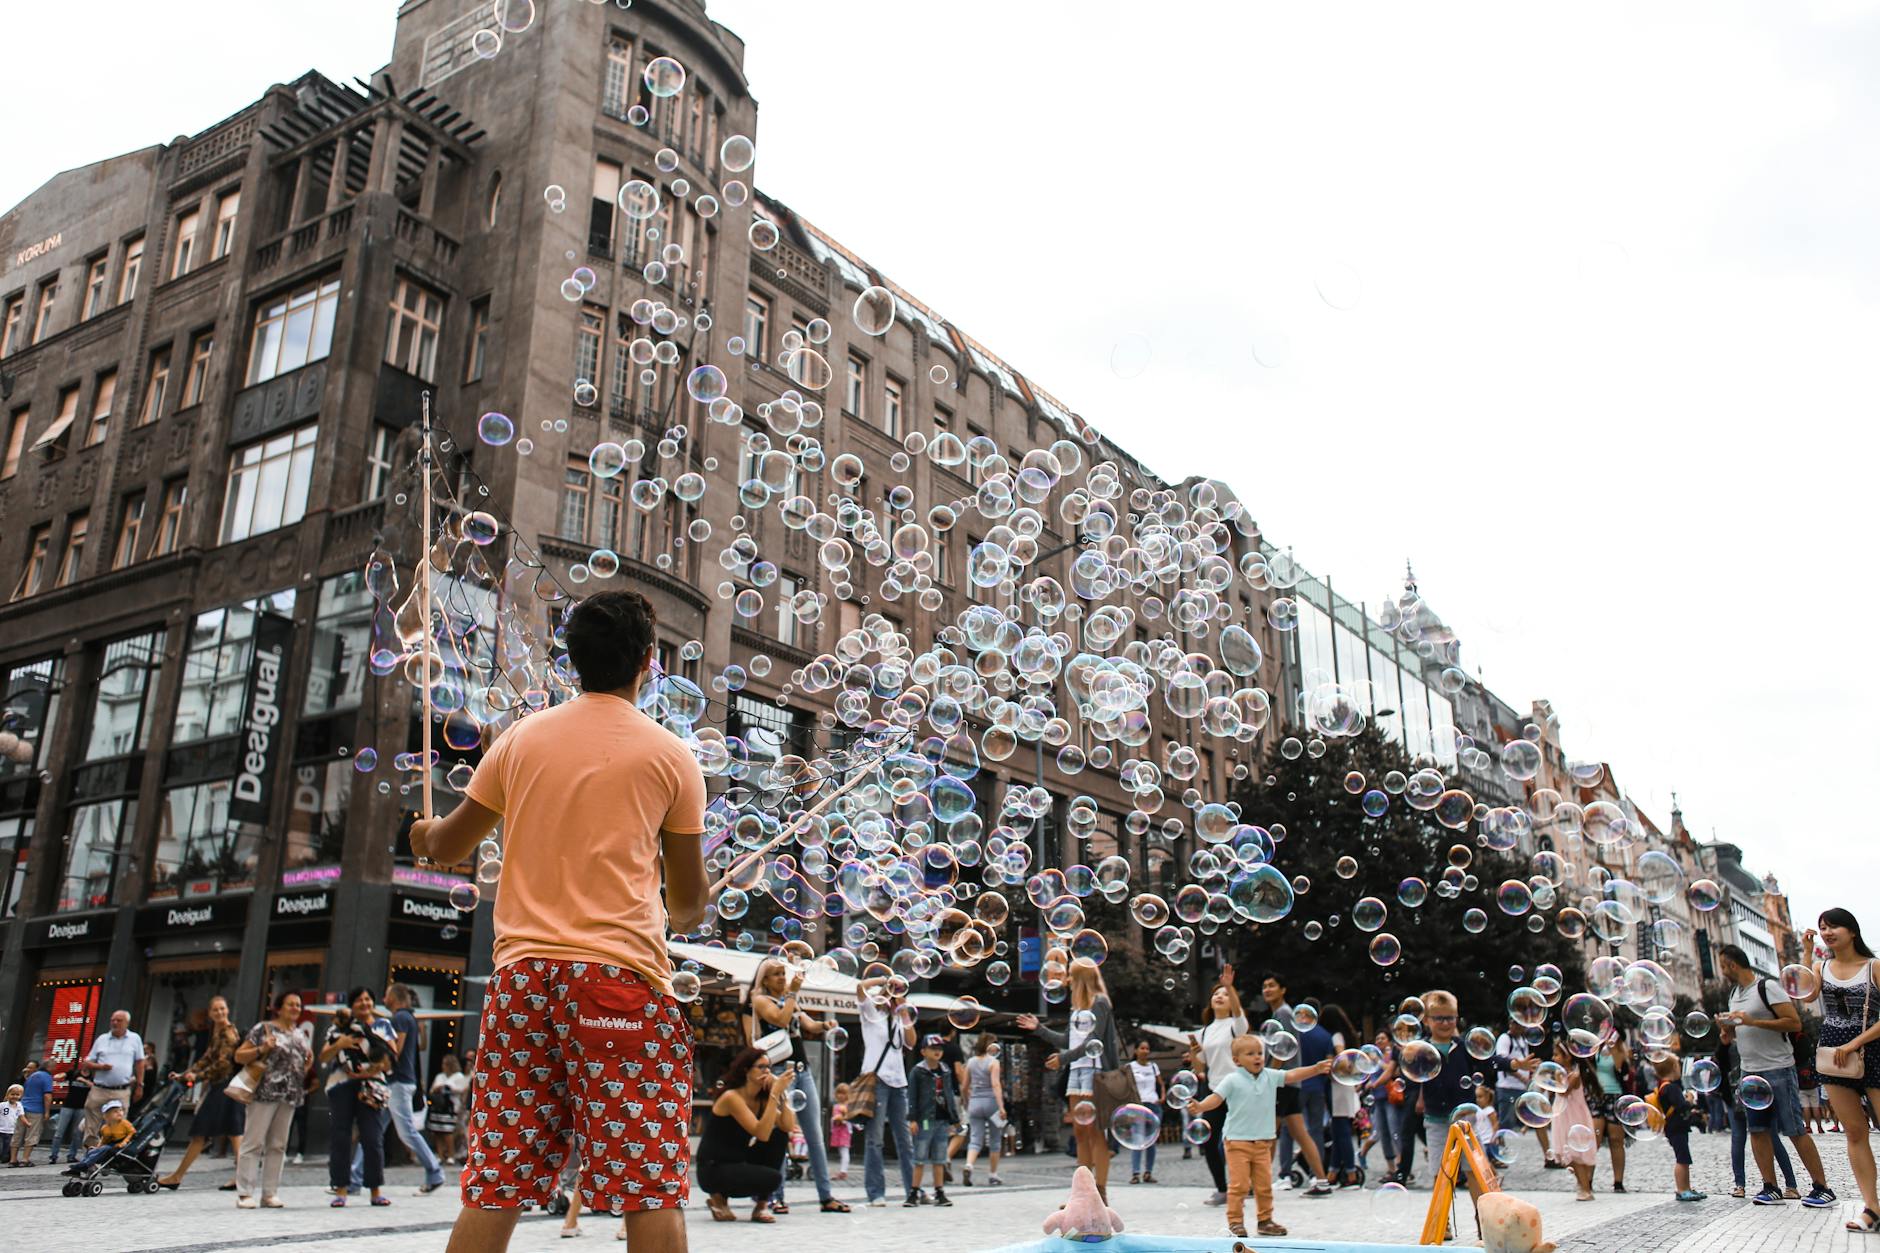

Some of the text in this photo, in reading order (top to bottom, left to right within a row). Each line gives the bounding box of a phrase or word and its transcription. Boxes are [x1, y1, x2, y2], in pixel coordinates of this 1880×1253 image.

[16, 231, 62, 267] KORUNA
[234, 648, 282, 803] Desigual
[277, 893, 327, 915] Desigual
[403, 899, 459, 921] Desigual
[167, 905, 212, 926] Desigual
[48, 920, 89, 939] Desigual
[578, 1014, 643, 1030] kanYeWest
[3, 1107, 10, 1116] 9
